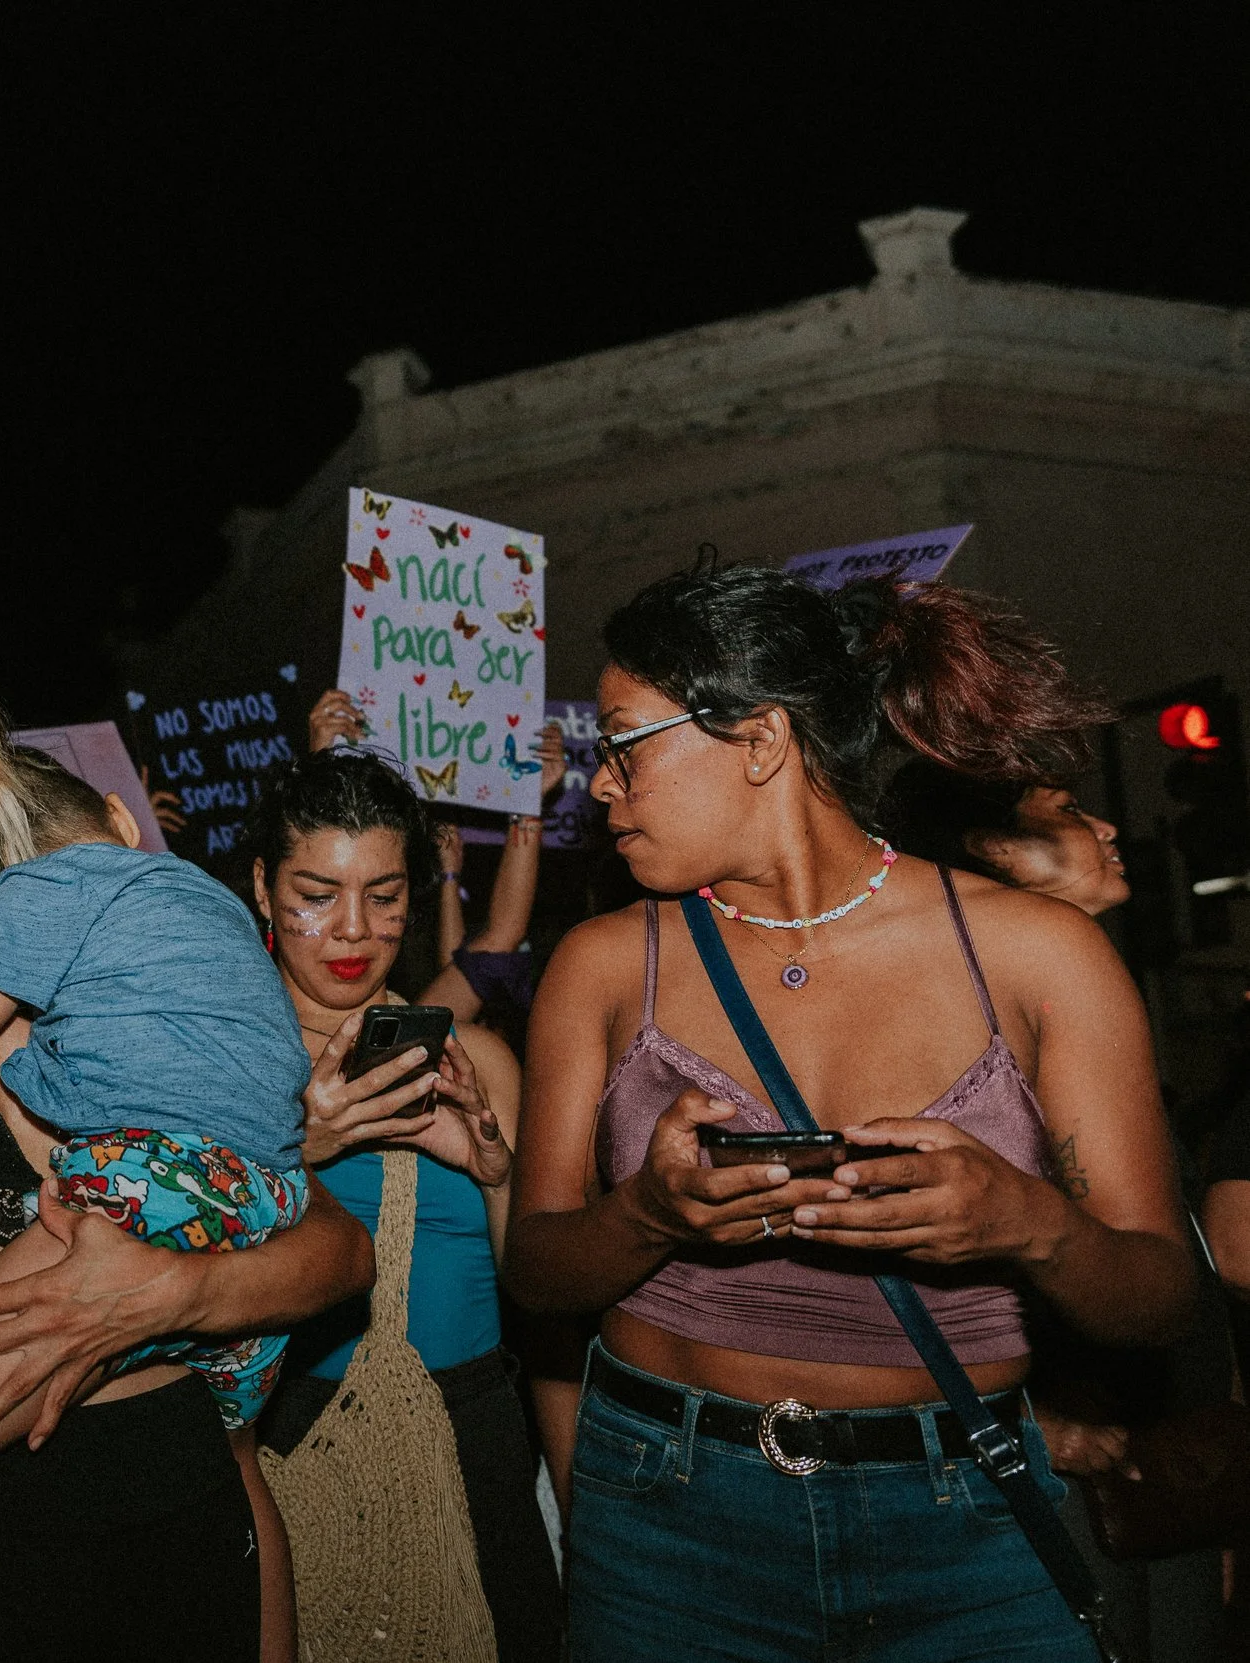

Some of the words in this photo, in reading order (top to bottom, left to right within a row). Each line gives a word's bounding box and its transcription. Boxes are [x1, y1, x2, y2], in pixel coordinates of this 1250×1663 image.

[396, 553, 486, 608] nací
[477, 637, 535, 687] ser
[154, 707, 190, 740] NO
[198, 691, 278, 734] SOMOS
[398, 692, 493, 766] libre
[160, 747, 205, 780] LAS
[224, 734, 293, 770] MUSAS
[180, 778, 248, 814] SOMOS
